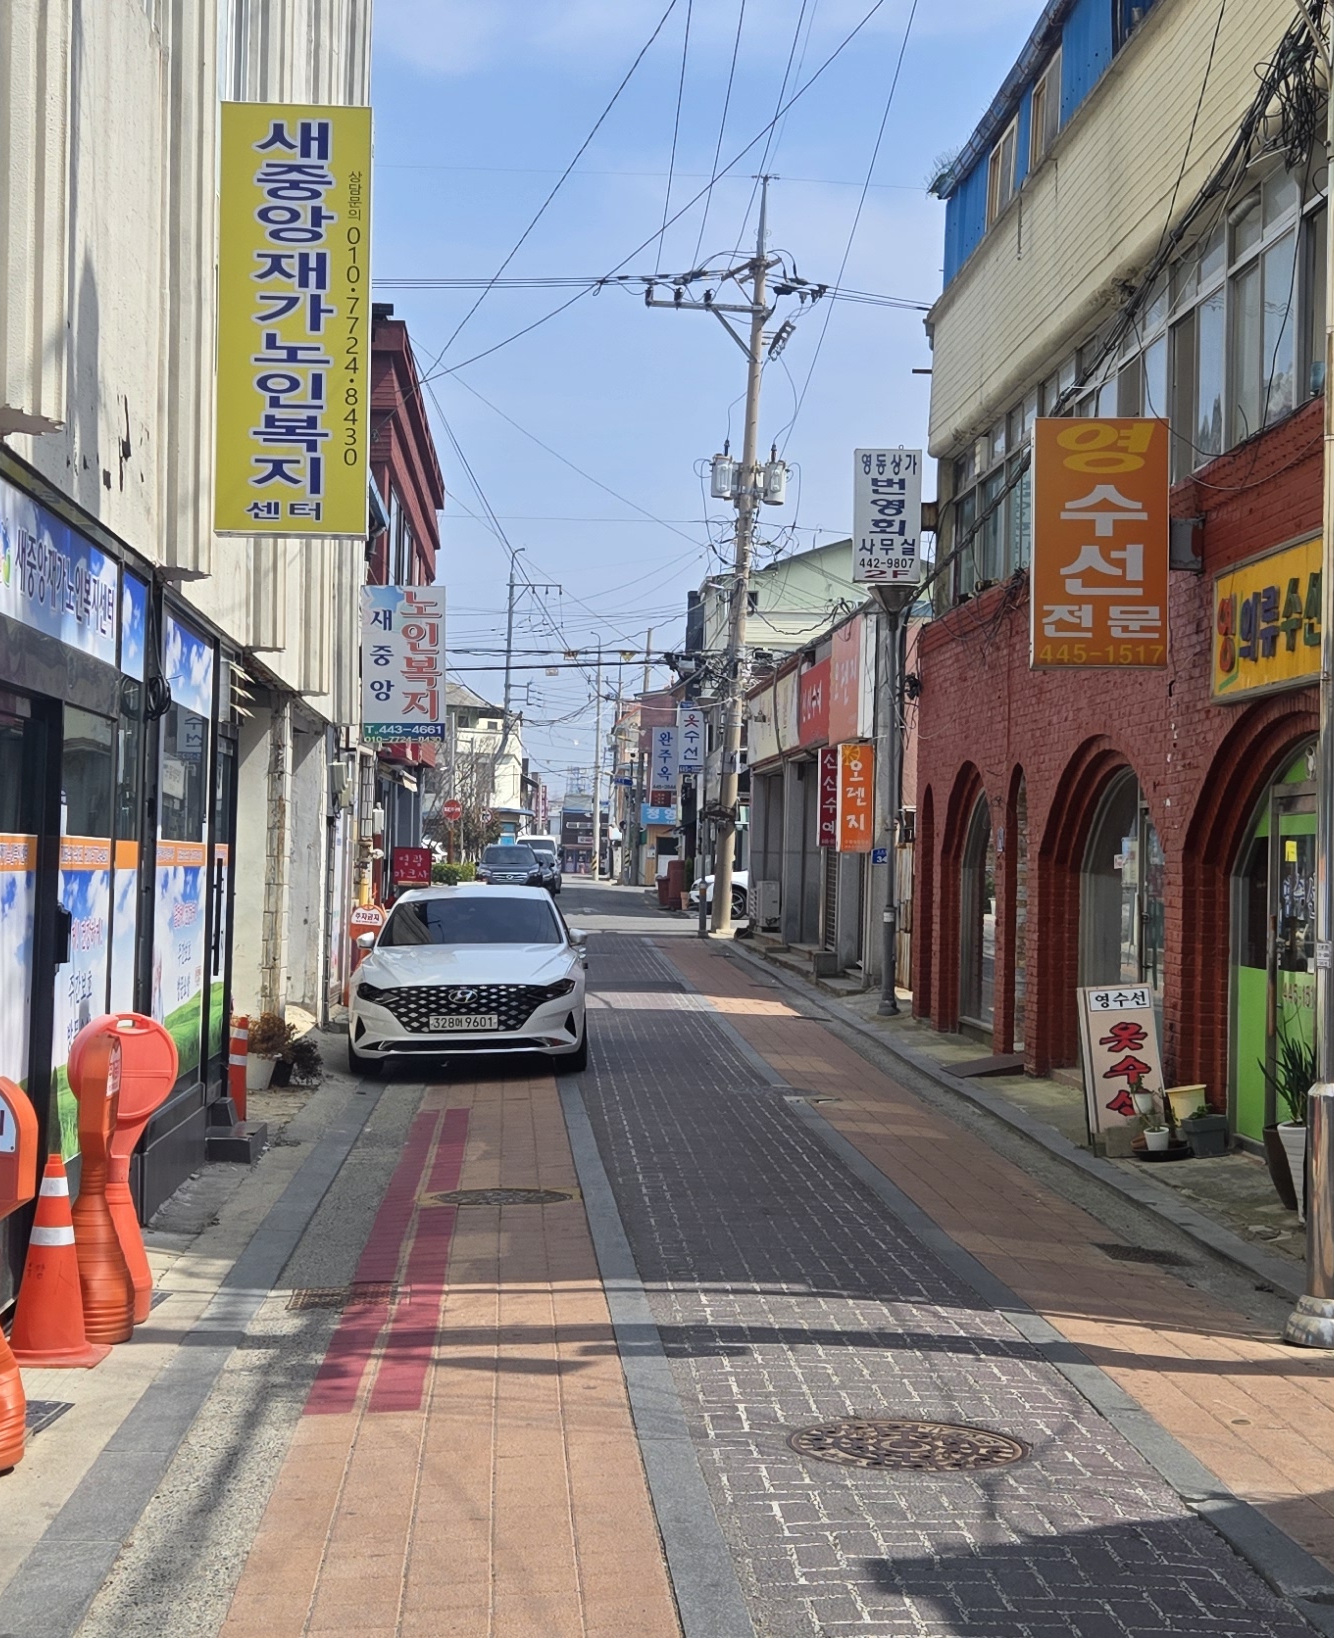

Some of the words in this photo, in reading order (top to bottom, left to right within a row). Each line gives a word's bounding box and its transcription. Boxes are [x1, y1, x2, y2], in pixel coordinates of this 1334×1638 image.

[861, 453, 917, 475] 영동상가
[245, 501, 323, 522] 센터
[869, 477, 906, 537] 번영회
[859, 538, 915, 556] 사무실
[859, 558, 915, 568] 442-9807
[1042, 604, 1162, 639] 전문
[369, 608, 395, 702] 새중앙
[400, 590, 443, 722] 노인복지
[1039, 644, 1164, 664] 445-1517
[683, 713, 700, 761] 옷수선
[657, 731, 674, 782] 완주옥
[846, 759, 867, 831] 오렌지
[1094, 990, 1147, 1009] 영수선
[464, 1016, 493, 1028] 9601
